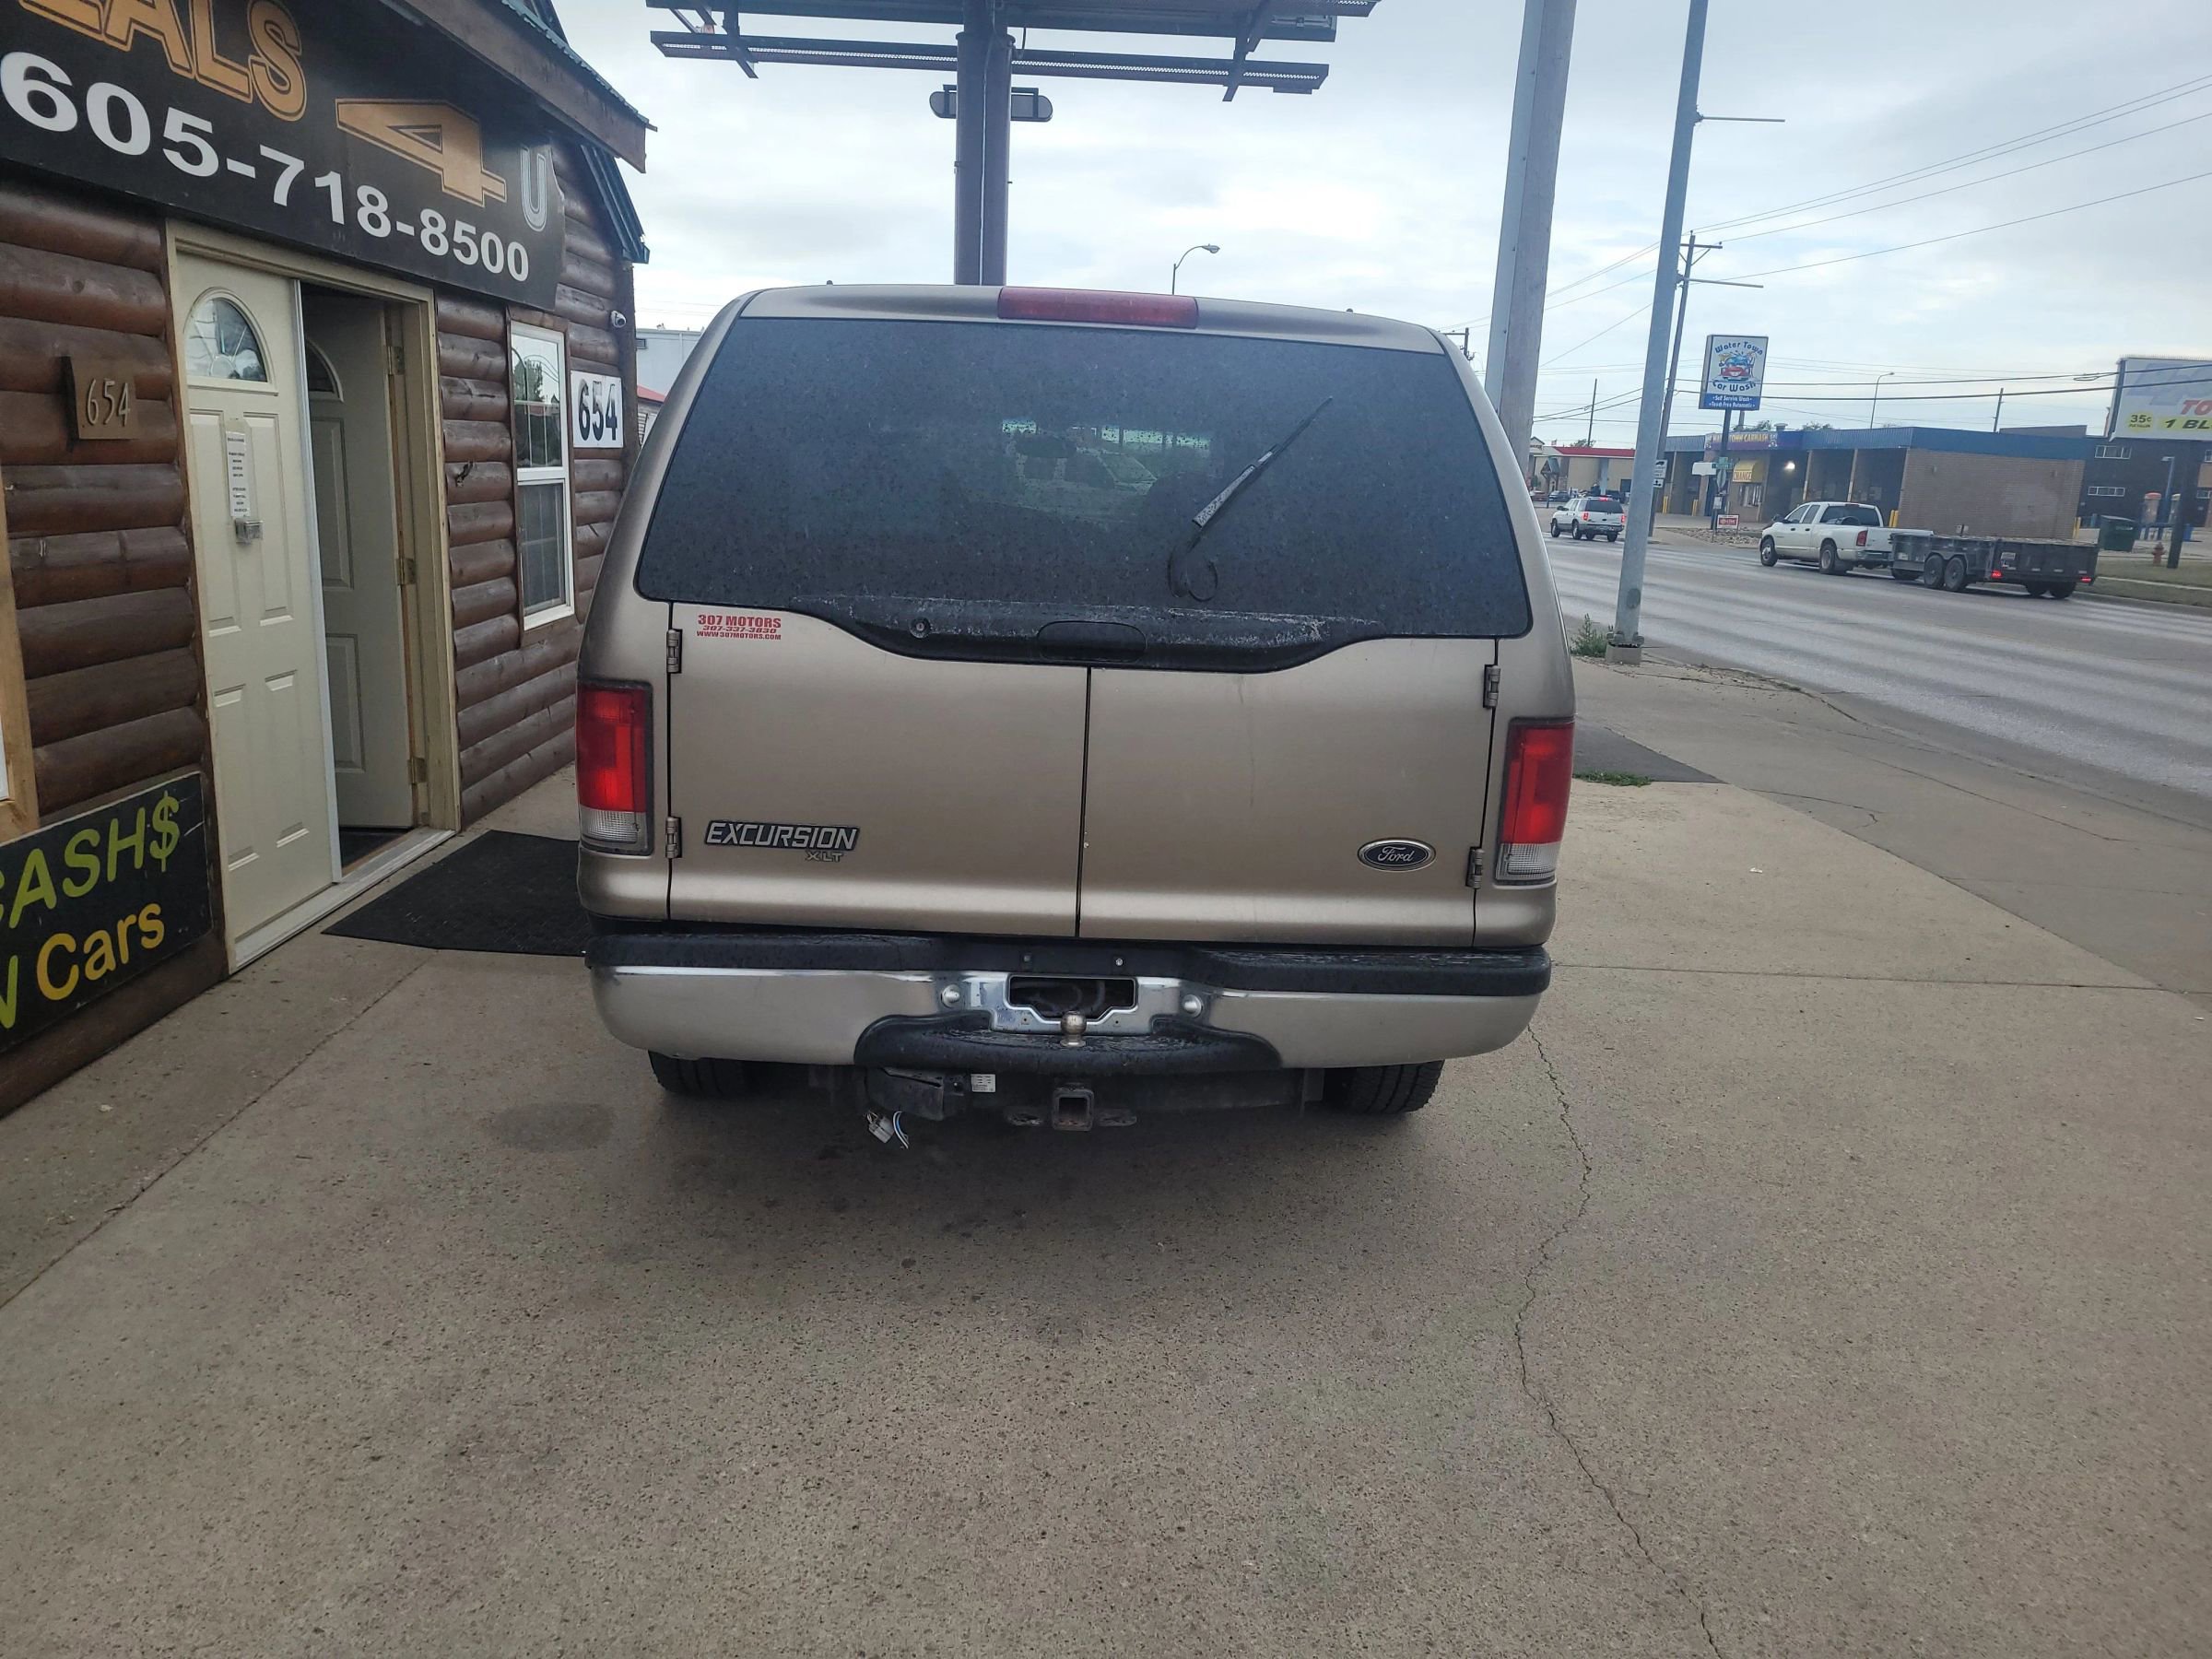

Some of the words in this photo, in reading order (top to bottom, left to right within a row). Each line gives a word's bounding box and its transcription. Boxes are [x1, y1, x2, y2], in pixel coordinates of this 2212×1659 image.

[0, 52, 529, 282] 605-718-8500
[335, 98, 506, 208] 4
[520, 144, 547, 232] U
[1714, 342, 1741, 354] Water
[1744, 341, 1763, 356] Town
[1712, 380, 1726, 391] Car
[1729, 382, 1758, 393] Wash
[87, 378, 131, 426] 654
[578, 378, 618, 441] 654
[2165, 418, 2177, 429] 1
[698, 614, 723, 626] 307
[725, 616, 782, 629] MOTORS
[705, 820, 857, 850] EXCURSION
[0, 791, 181, 929] ASH$
[805, 850, 844, 863] XLT
[1377, 845, 1416, 862] Ford
[36, 902, 166, 1001] Cars
